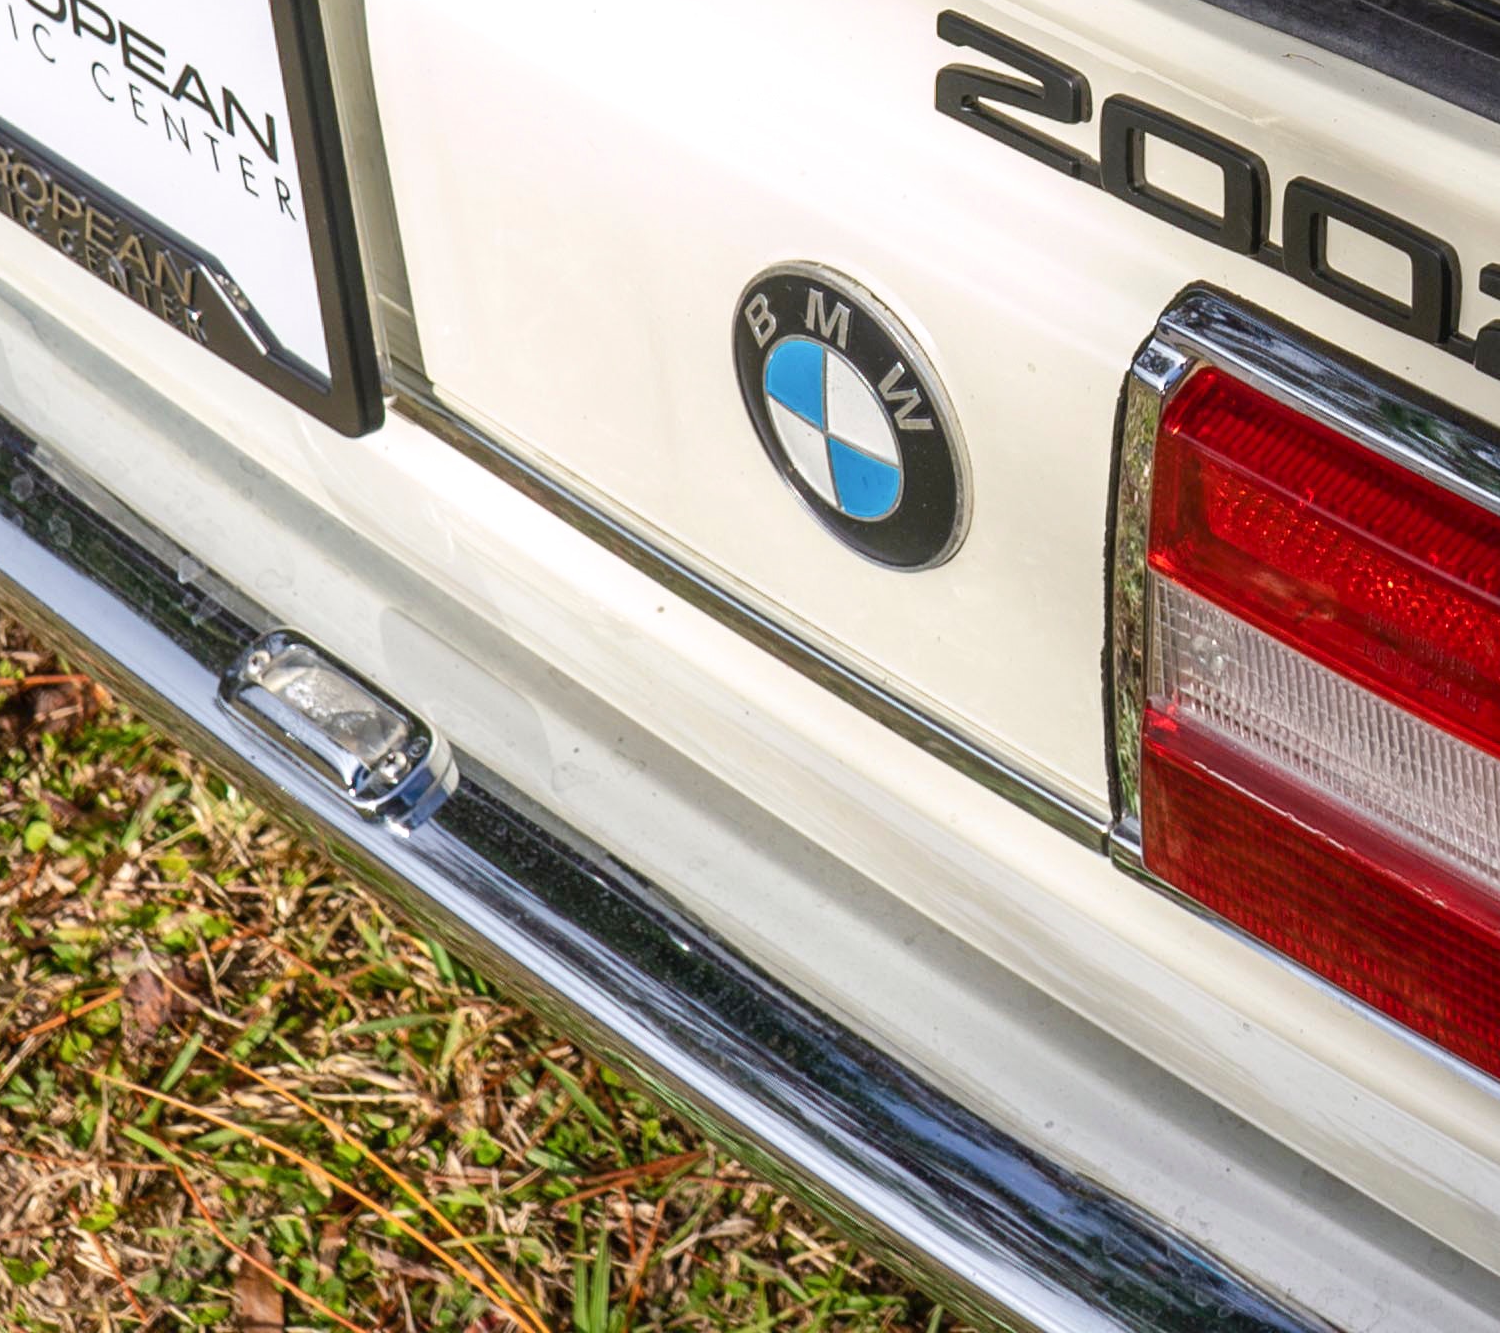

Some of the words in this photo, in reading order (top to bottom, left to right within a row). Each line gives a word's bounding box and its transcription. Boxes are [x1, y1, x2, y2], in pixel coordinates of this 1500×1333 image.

[91, 61, 297, 222] CENTER
[57, 228, 208, 343] CENTER
[742, 291, 934, 434] BMW
